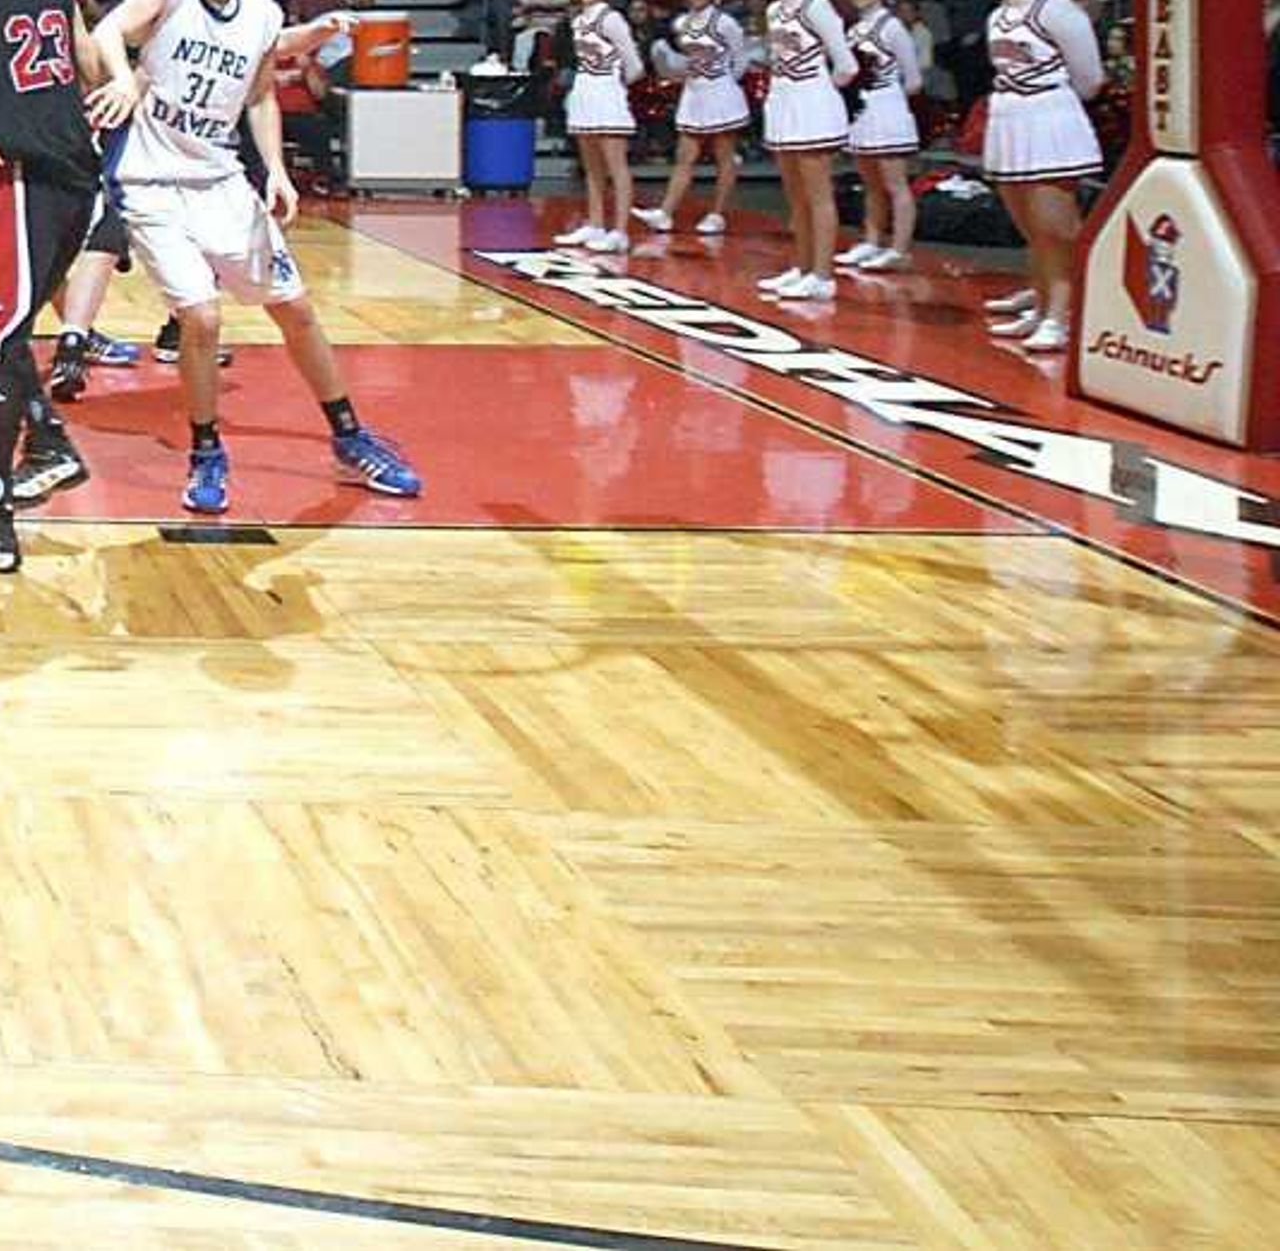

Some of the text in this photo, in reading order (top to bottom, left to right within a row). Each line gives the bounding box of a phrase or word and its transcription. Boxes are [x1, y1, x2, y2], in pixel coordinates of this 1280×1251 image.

[4, 8, 75, 94] 23
[171, 37, 249, 81] NOTRE
[181, 72, 216, 110] 31
[151, 100, 231, 141] DAME
[1088, 332, 1223, 386] Schnucks
